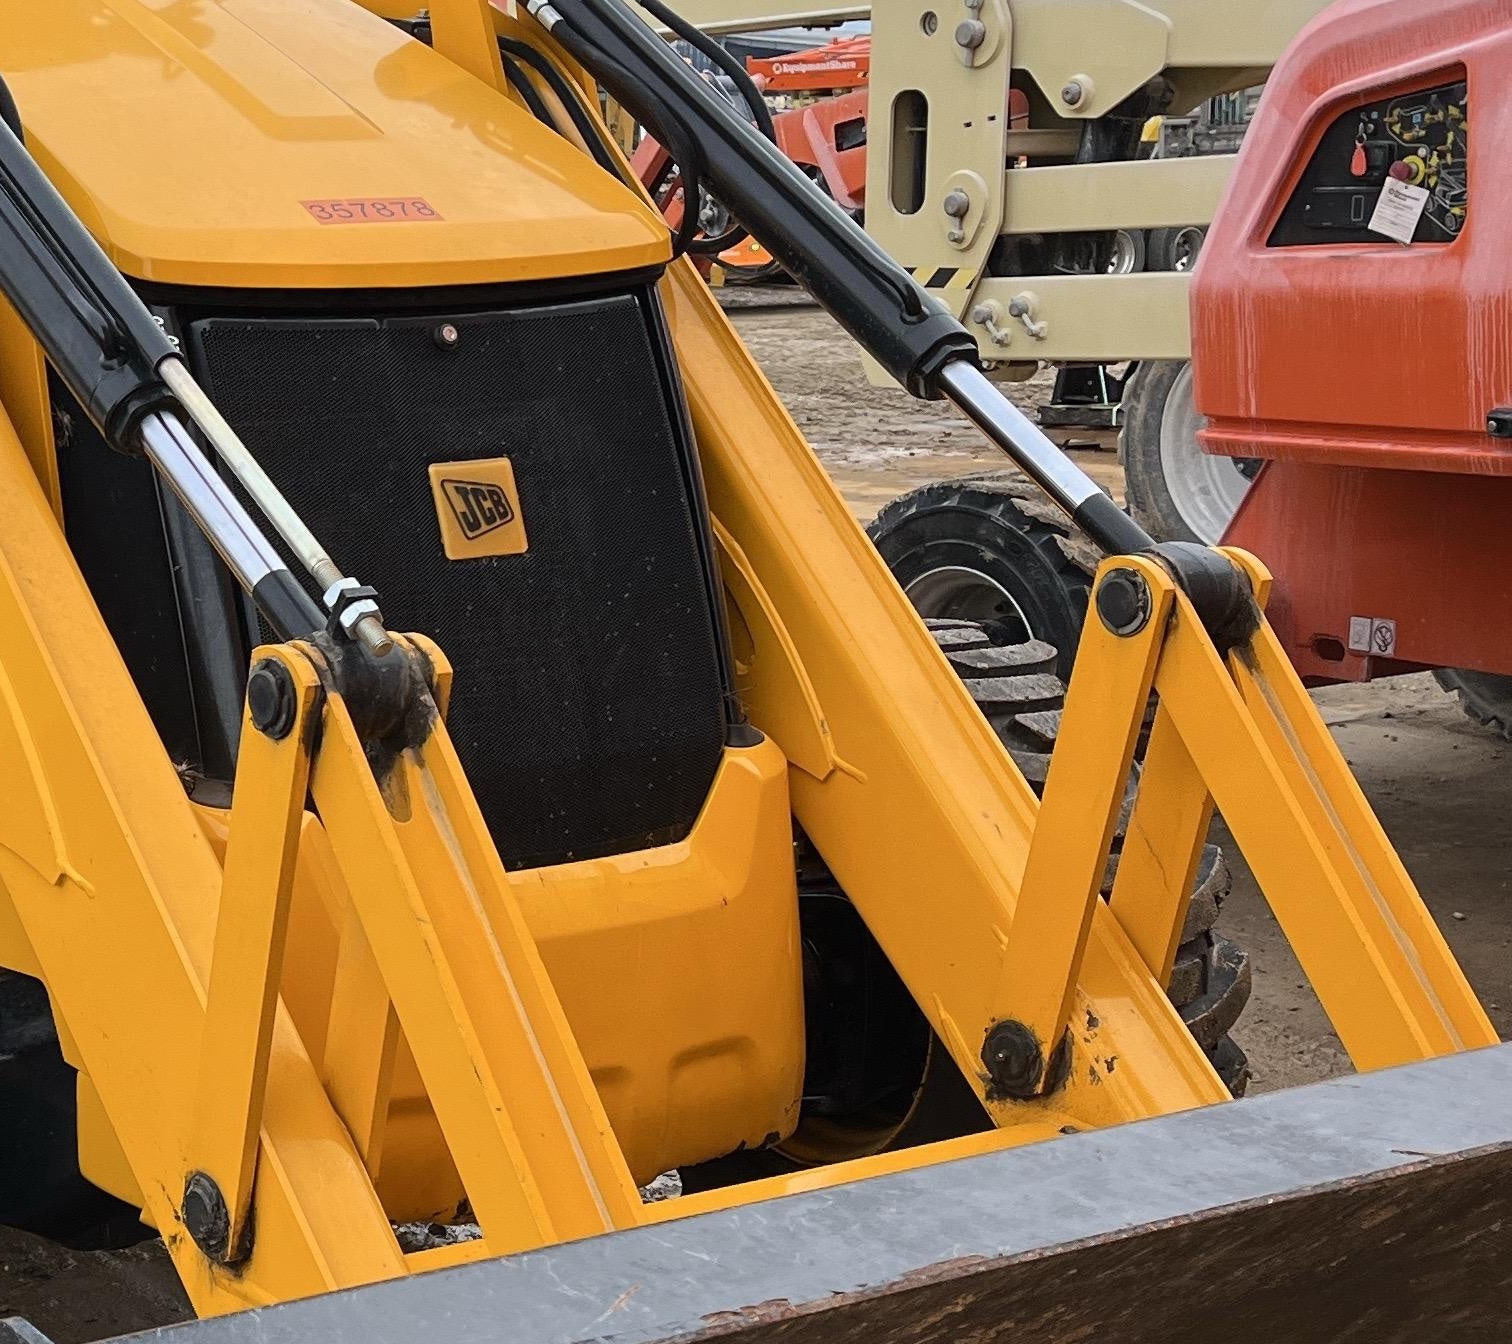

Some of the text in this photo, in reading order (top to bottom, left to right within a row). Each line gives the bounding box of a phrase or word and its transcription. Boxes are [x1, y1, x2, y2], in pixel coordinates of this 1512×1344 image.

[783, 61, 856, 73] EquipmentShare
[309, 201, 436, 220] 357878
[453, 485, 510, 532] JCB
